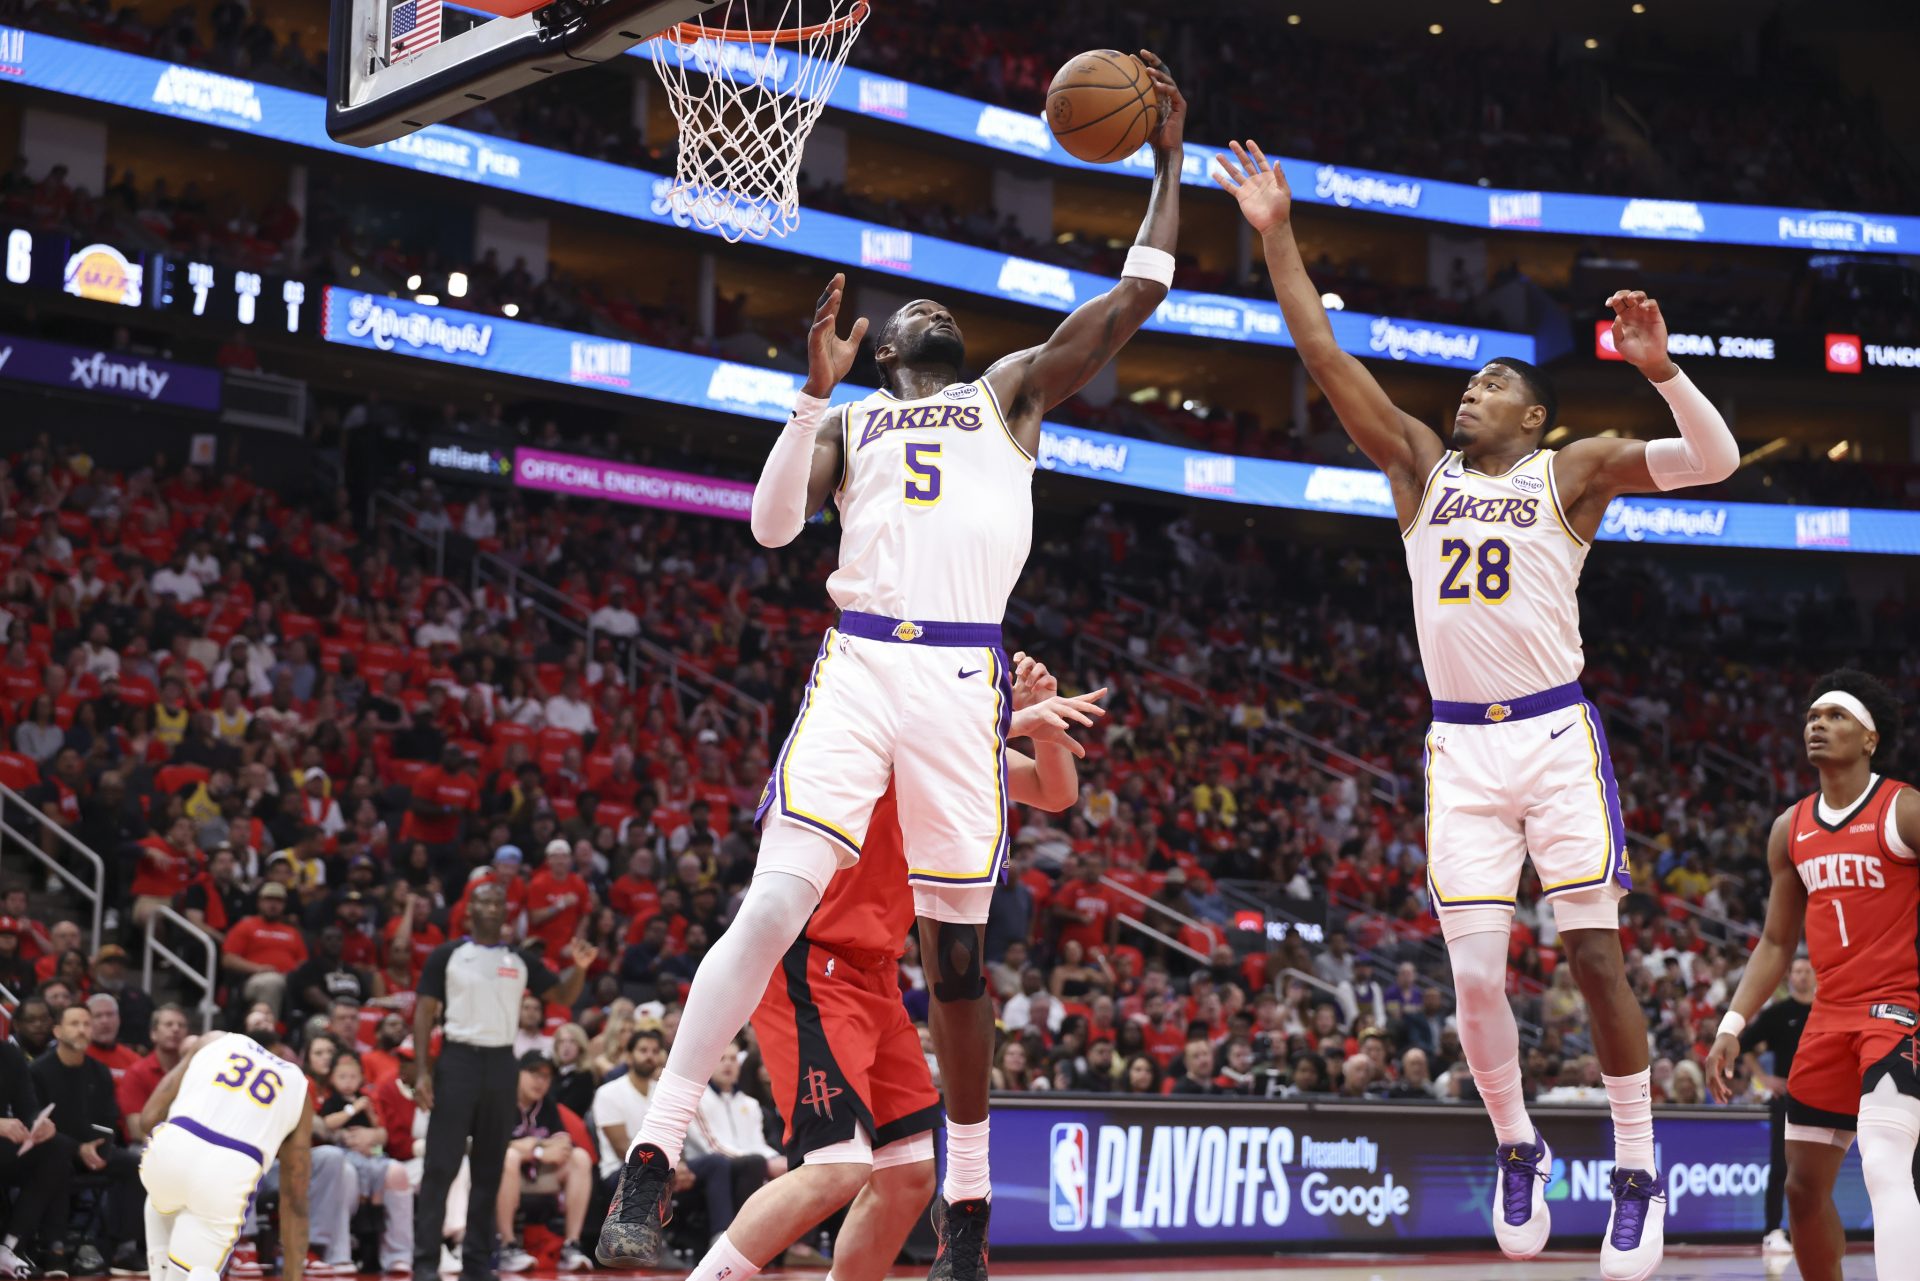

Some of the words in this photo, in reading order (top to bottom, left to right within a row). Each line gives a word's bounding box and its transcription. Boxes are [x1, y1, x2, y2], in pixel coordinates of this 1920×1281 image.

[1719, 336, 1775, 359] ZONE
[70, 352, 170, 400] xfinity
[857, 404, 983, 453] LAKERS
[429, 445, 490, 473] reliant
[520, 457, 602, 490] OFFICIAL
[903, 441, 943, 507] 5
[1514, 477, 1543, 489] bibigo
[1428, 486, 1540, 529] LAKERS
[1438, 537, 1512, 605] 28
[1832, 899, 1849, 947] 1
[211, 1052, 283, 1109] 36
[1091, 1125, 1294, 1229] PLAYOFFS
[1300, 1172, 1410, 1226] Google
